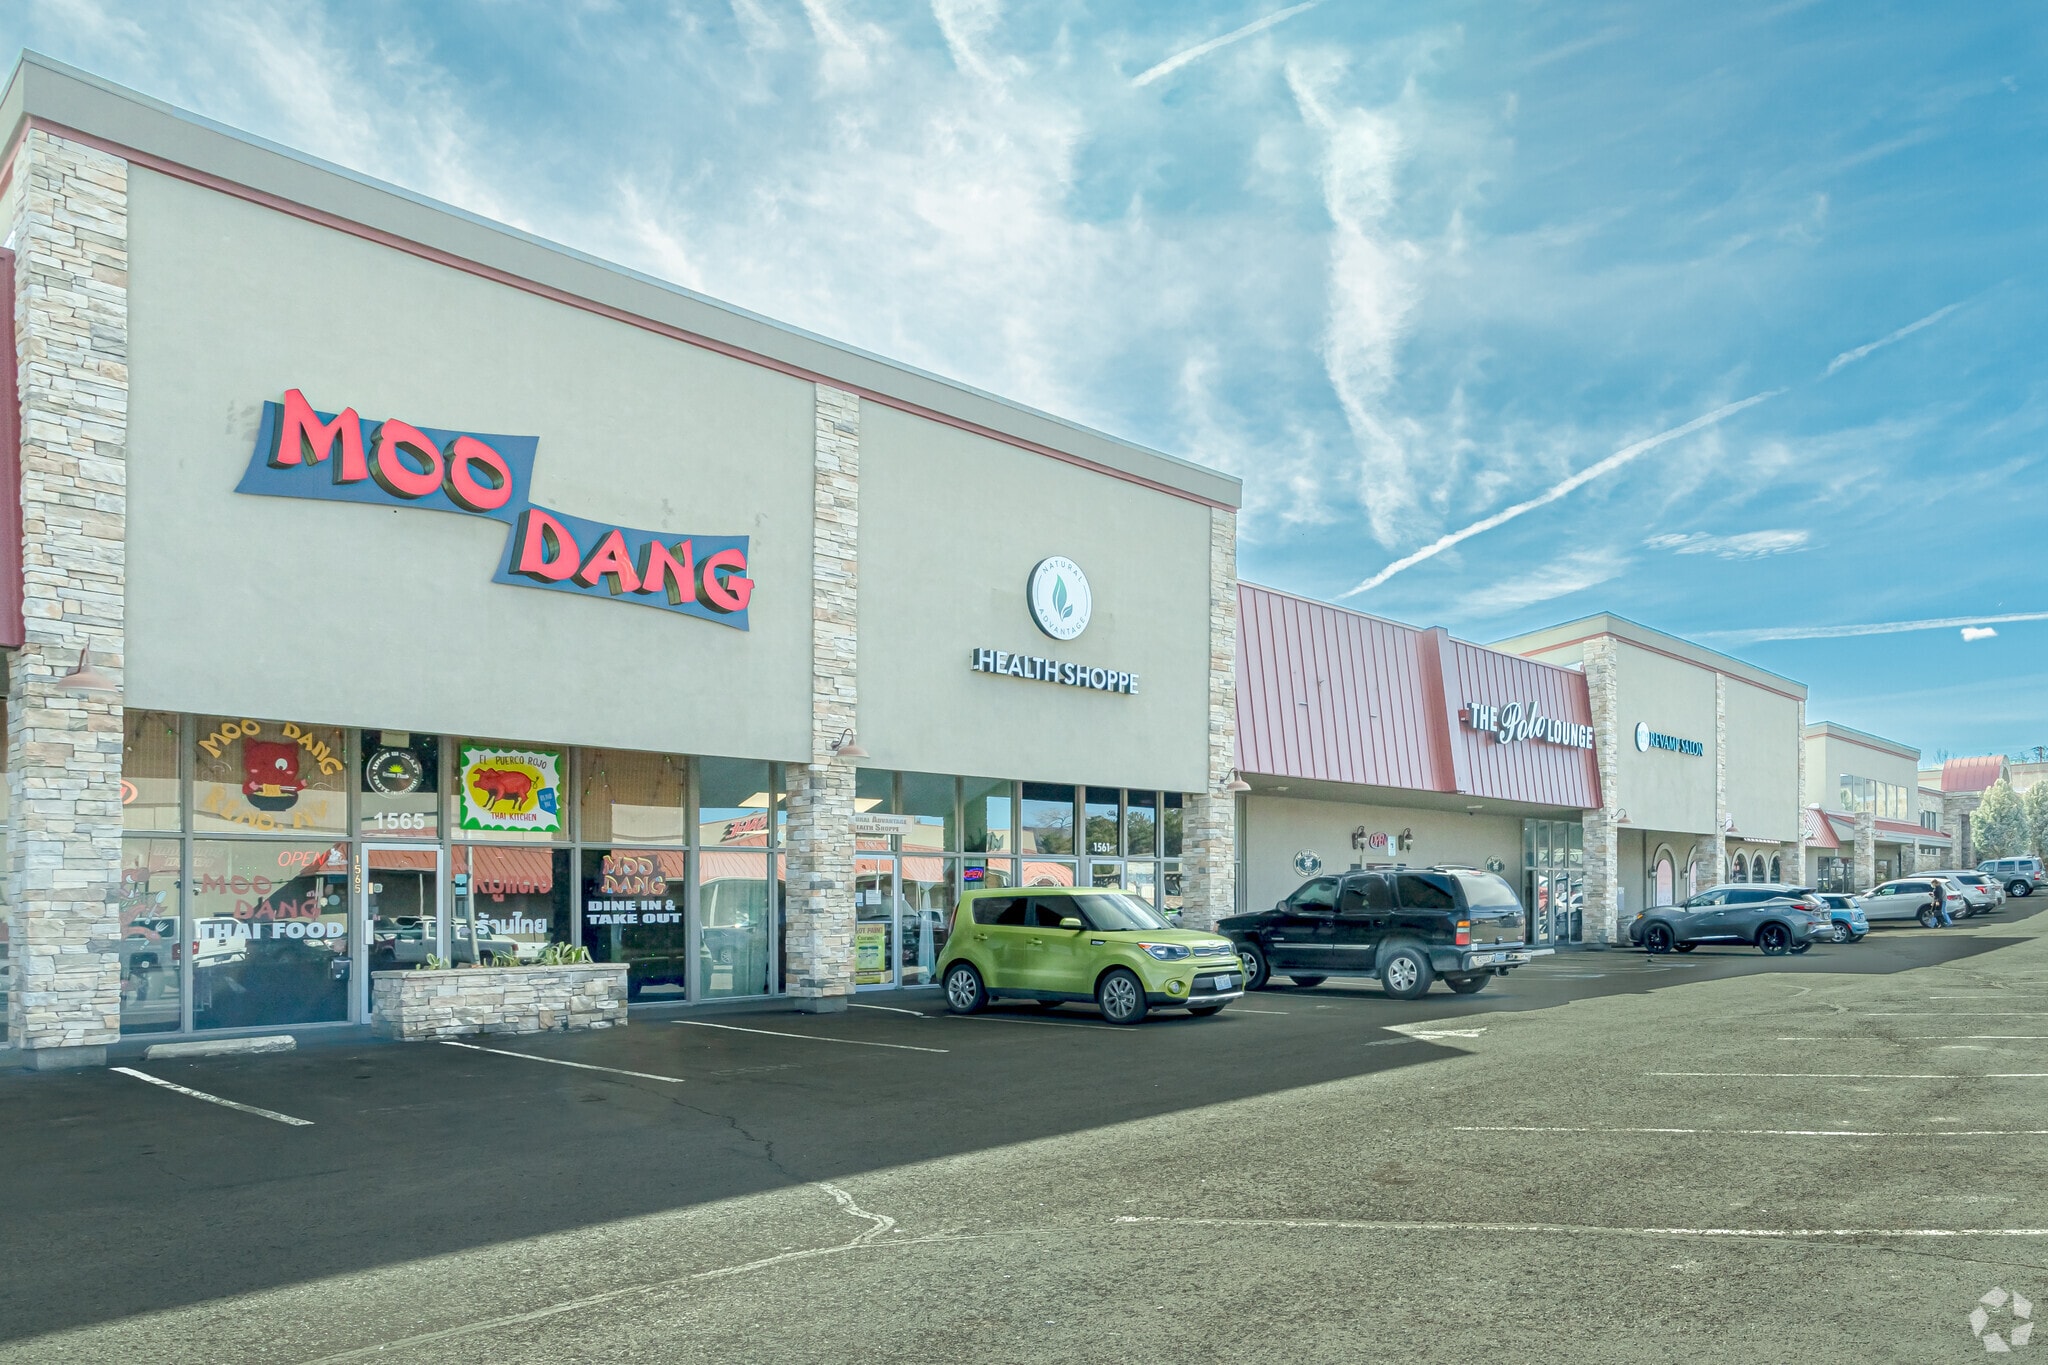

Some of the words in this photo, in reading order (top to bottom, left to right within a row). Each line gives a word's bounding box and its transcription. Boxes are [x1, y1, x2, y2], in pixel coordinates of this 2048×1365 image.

[268, 388, 513, 513] MOO
[510, 508, 755, 614] DANG
[1042, 560, 1084, 583] NATURAL
[1038, 607, 1086, 635] ADVANTAGE
[974, 648, 1059, 682] HEALTH
[1060, 663, 1139, 694] SHOPPE
[1468, 702, 1497, 732] THE
[1499, 701, 1545, 744] Polo
[1546, 718, 1593, 749] LOUNGE
[198, 719, 261, 758] MOO
[282, 722, 343, 776] DANG
[1650, 731, 1678, 752] REVAMP
[1679, 739, 1703, 757] SALON
[479, 755, 488, 765] EL
[495, 755, 525, 766] PUERCO
[528, 757, 547, 769] ROJO
[373, 812, 425, 830] 1565
[491, 812, 507, 821] THAI
[509, 812, 537, 822] KITCHEN
[1093, 842, 1110, 852] 1561
[278, 851, 327, 867] OPEN
[602, 855, 653, 875] MOO
[202, 873, 272, 895] MOO
[601, 874, 667, 896] DANG
[233, 899, 321, 919] DANG
[587, 900, 636, 912] DINE
[641, 900, 662, 911] IN
[664, 900, 676, 911] &
[477, 911, 547, 934] ร้านไทย
[586, 914, 638, 925] TAKE
[642, 913, 682, 924] OUT
[199, 922, 261, 940] THAI
[272, 922, 344, 939] FOOD
